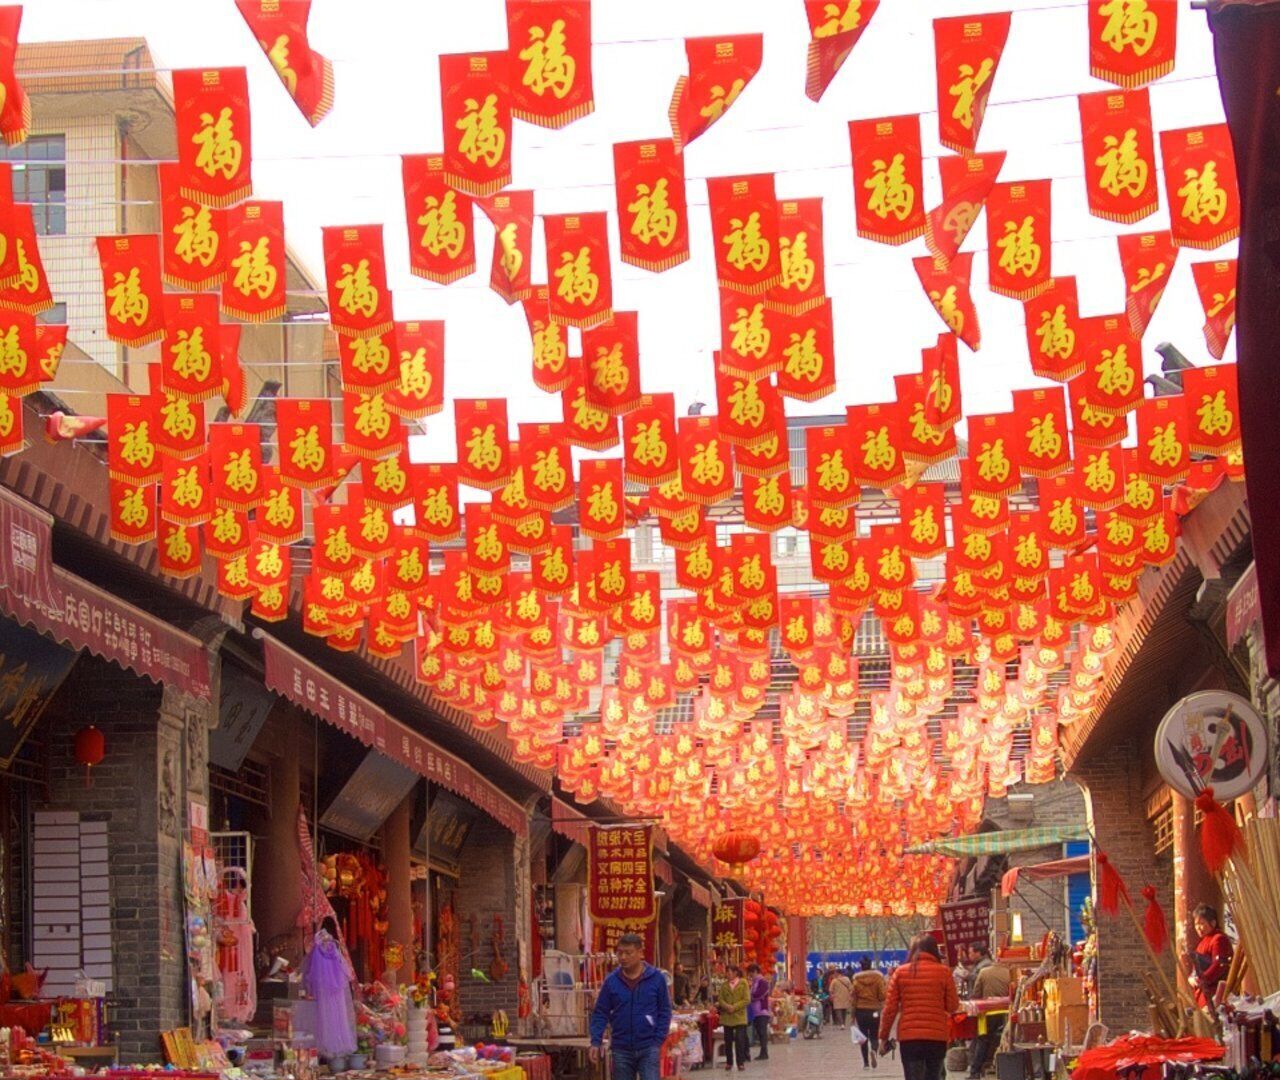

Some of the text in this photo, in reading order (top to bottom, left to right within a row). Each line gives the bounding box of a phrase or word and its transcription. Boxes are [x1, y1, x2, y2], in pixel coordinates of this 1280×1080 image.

[518, 19, 576, 99] 福
[191, 106, 243, 180] 福
[455, 94, 506, 168] 福
[1095, 128, 1148, 198] 福
[864, 153, 915, 221] 福
[1177, 160, 1227, 225] 福
[172, 199, 219, 267] 福
[417, 190, 466, 260] 福
[627, 177, 678, 247] 福
[722, 211, 771, 272] 福
[778, 231, 815, 292] 福
[996, 215, 1042, 278] 福
[231, 236, 278, 299] 福
[335, 259, 379, 318] 福
[554, 246, 599, 306] 福
[106, 267, 150, 327] 福
[348, 329, 390, 374] 福
[532, 318, 566, 373] 福
[729, 302, 771, 359] 福
[1035, 304, 1076, 359] 福
[170, 326, 212, 382] 福
[395, 347, 433, 400] 福
[589, 342, 630, 395] 福
[782, 328, 824, 383] 福
[1094, 343, 1136, 396] 福
[160, 389, 196, 441] 福
[353, 388, 395, 440] 福
[727, 371, 765, 428] 福
[1196, 389, 1233, 436] 福
[118, 420, 156, 468] 福
[289, 425, 325, 472] 福
[465, 424, 502, 472] 福
[631, 419, 668, 468] 福
[860, 426, 896, 471] 福
[1026, 412, 1062, 459] 福
[1147, 421, 1183, 468] 福
[223, 449, 258, 494] 福
[372, 454, 407, 494] 福
[530, 447, 566, 493] 福
[689, 439, 725, 486] 福
[815, 449, 850, 493] 福
[975, 438, 1011, 483] 福
[1083, 450, 1116, 493] 福
[119, 482, 149, 529] 福
[171, 466, 203, 509] 福
[262, 486, 295, 529] 福
[422, 486, 453, 527] 福
[586, 481, 618, 524] 福
[753, 475, 785, 516] 福
[1123, 473, 1155, 510] 福
[211, 504, 242, 545] 福
[360, 502, 389, 543] 福
[909, 506, 939, 544] 福
[1048, 497, 1078, 536] 福
[1105, 511, 1134, 546] 福
[1143, 516, 1170, 553] 福
[164, 520, 193, 563] 福
[255, 542, 283, 579] 福
[323, 525, 357, 564] 福
[474, 524, 503, 562] 福
[684, 542, 713, 579] 福
[821, 541, 849, 571] 福
[877, 545, 906, 581] 福
[1013, 532, 1043, 569] 福
[225, 553, 250, 587] 福
[350, 558, 376, 594] 福
[396, 547, 424, 582] 福
[540, 547, 568, 584] 福
[599, 560, 625, 596] 福
[738, 554, 765, 589] 福
[1070, 571, 1094, 601] 福
[516, 588, 541, 622] 福
[629, 590, 655, 623] 福
[683, 617, 705, 648] 福
[597, 861, 647, 875] 文房四宝
[598, 877, 647, 894] 品种齐全
